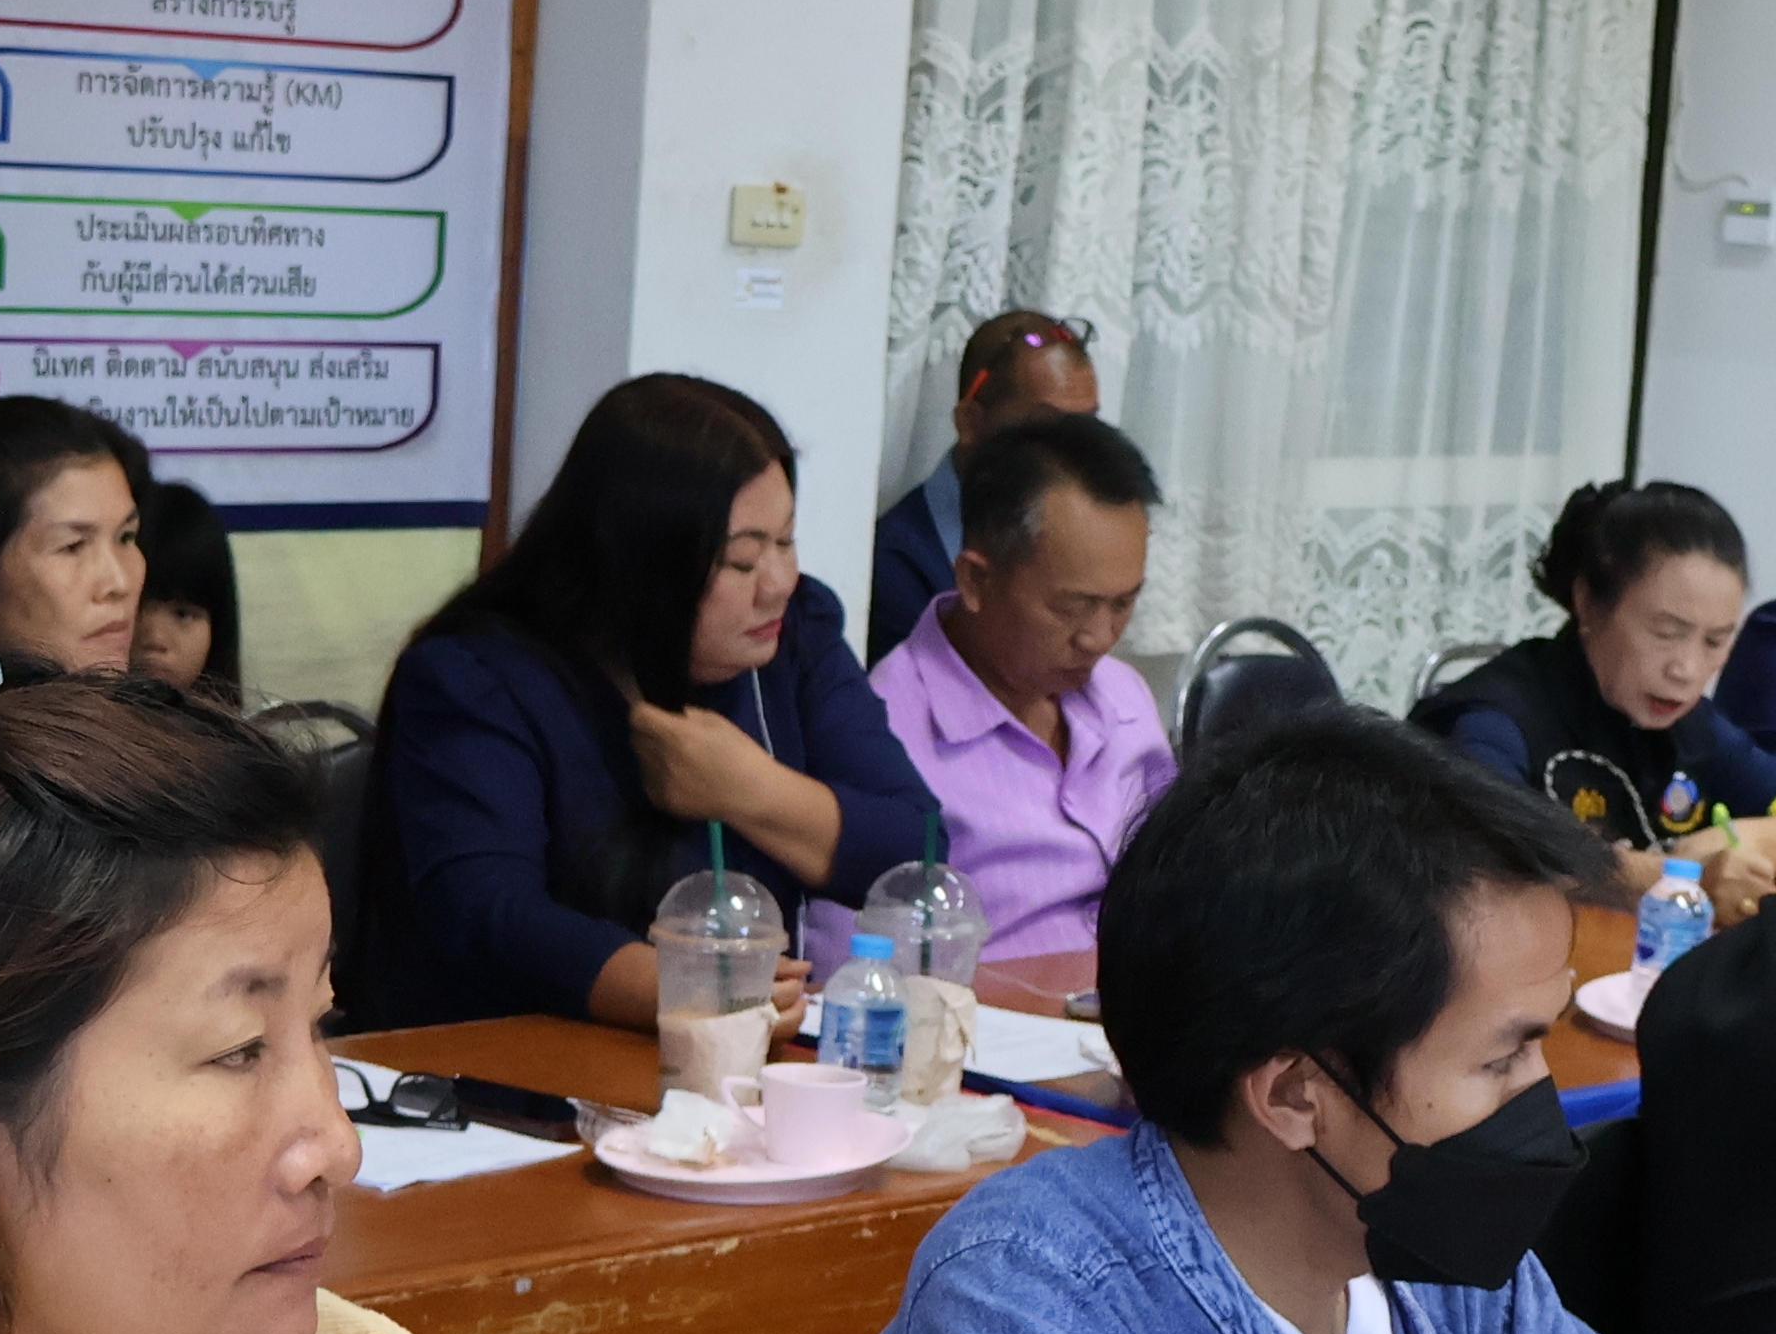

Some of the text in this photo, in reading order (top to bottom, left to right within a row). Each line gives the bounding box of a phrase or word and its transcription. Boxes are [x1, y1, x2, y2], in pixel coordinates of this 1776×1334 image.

[76, 63, 344, 117] การจัดการความรู้ (KM)
[127, 116, 292, 160] ปรับปรุง แก้ไข
[105, 349, 187, 381] ติดตาม
[196, 348, 300, 389] สนับสนุน
[308, 350, 389, 382] ส่งเสริม
